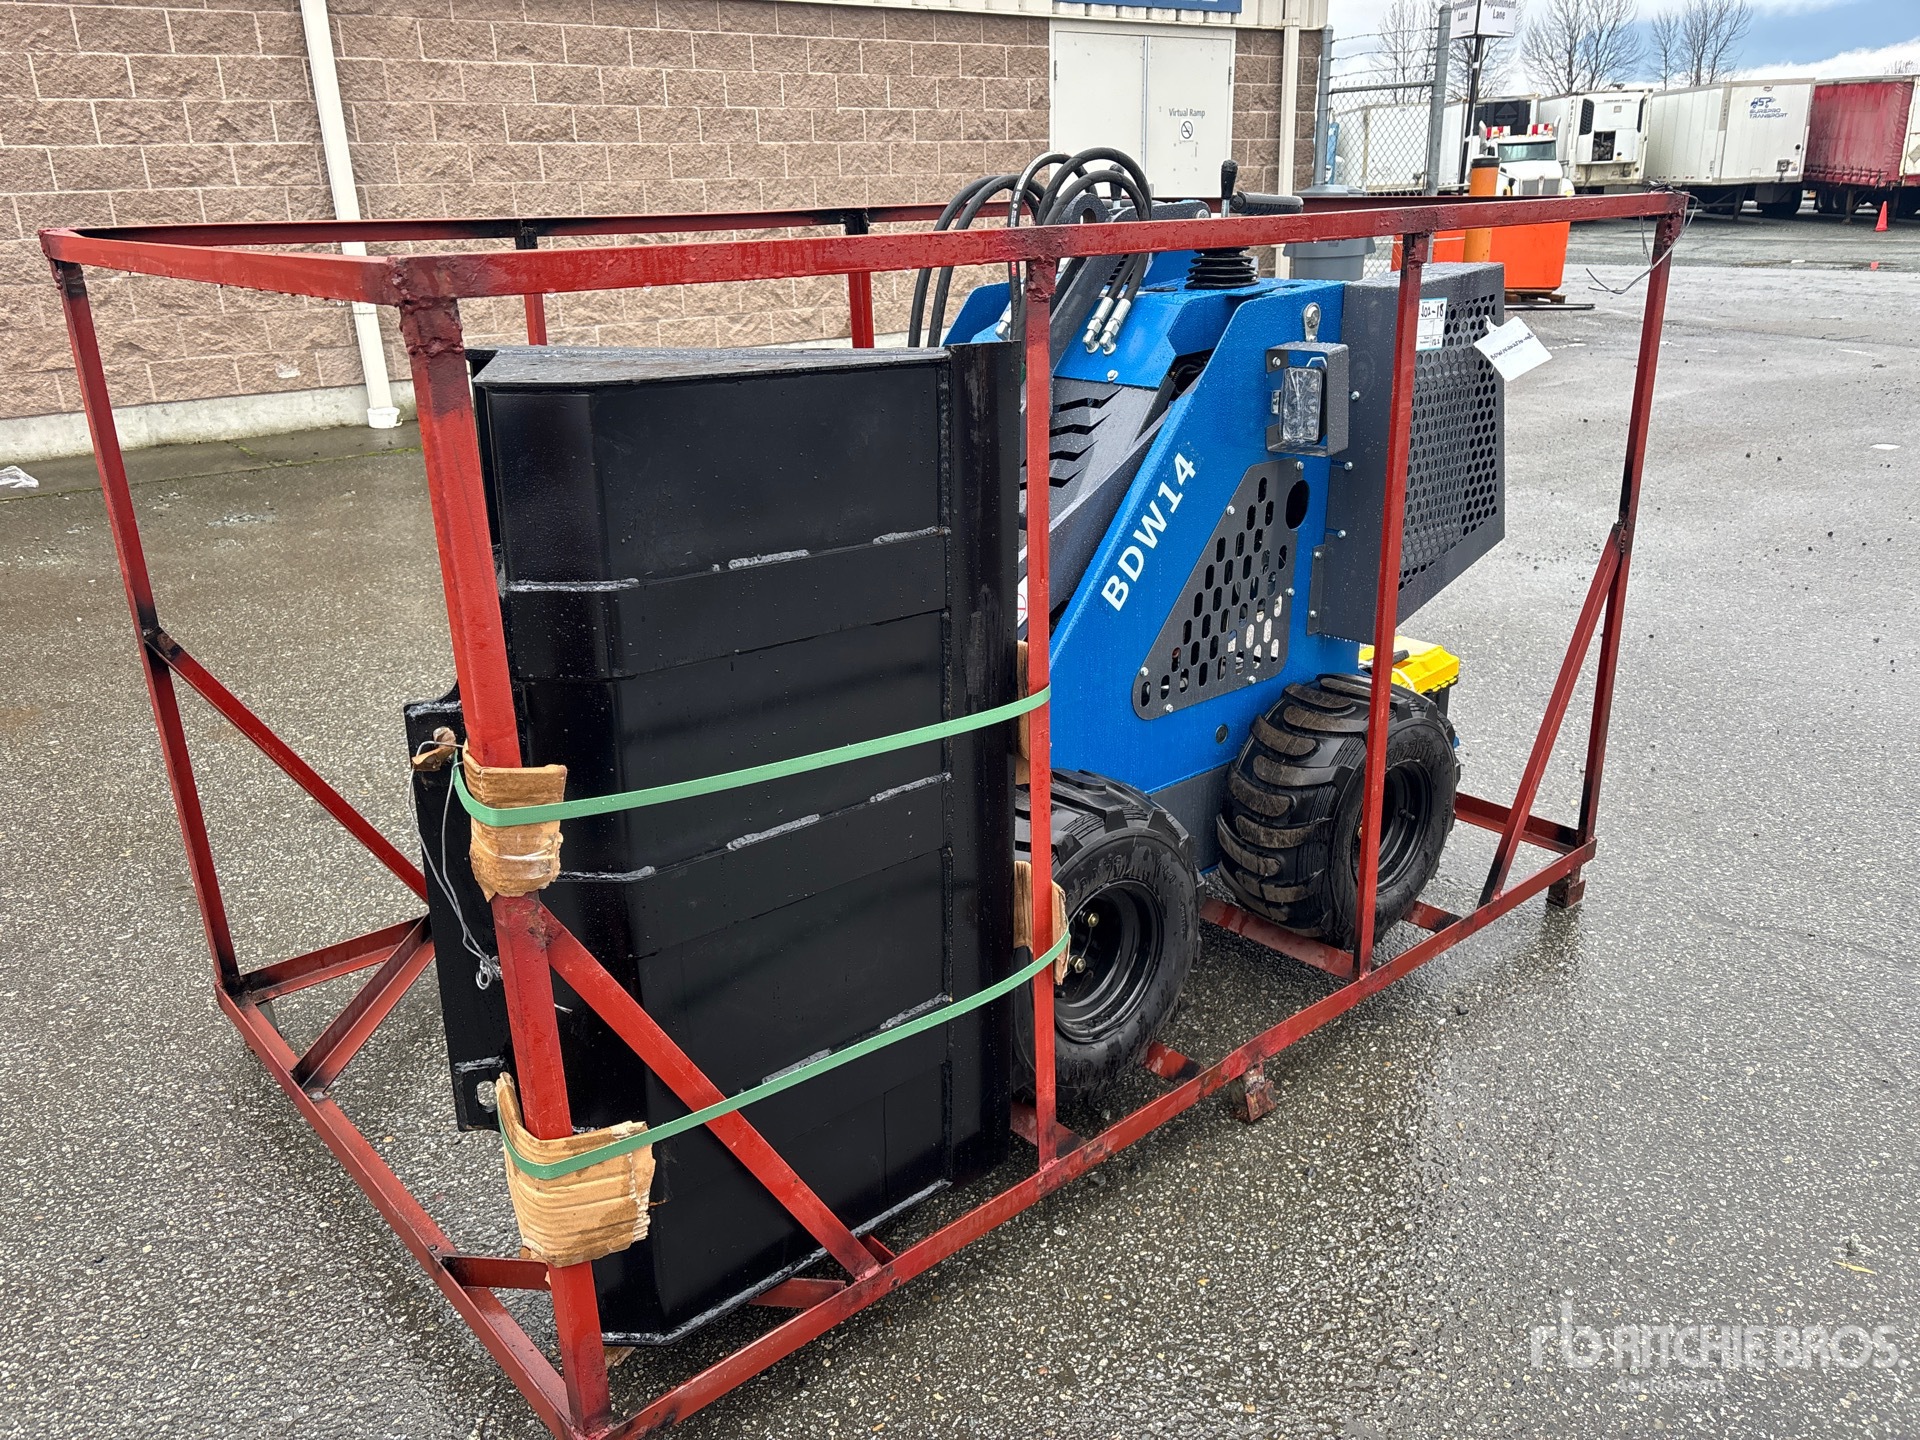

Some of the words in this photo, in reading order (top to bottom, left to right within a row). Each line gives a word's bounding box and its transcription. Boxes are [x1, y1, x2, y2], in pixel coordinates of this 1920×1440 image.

[1458, 11, 1469, 21] Lane
[1493, 8, 1506, 20] Lane
[1169, 108, 1188, 117] Virtual
[1189, 108, 1206, 118] Ramp
[1100, 451, 1197, 611] BDW14
